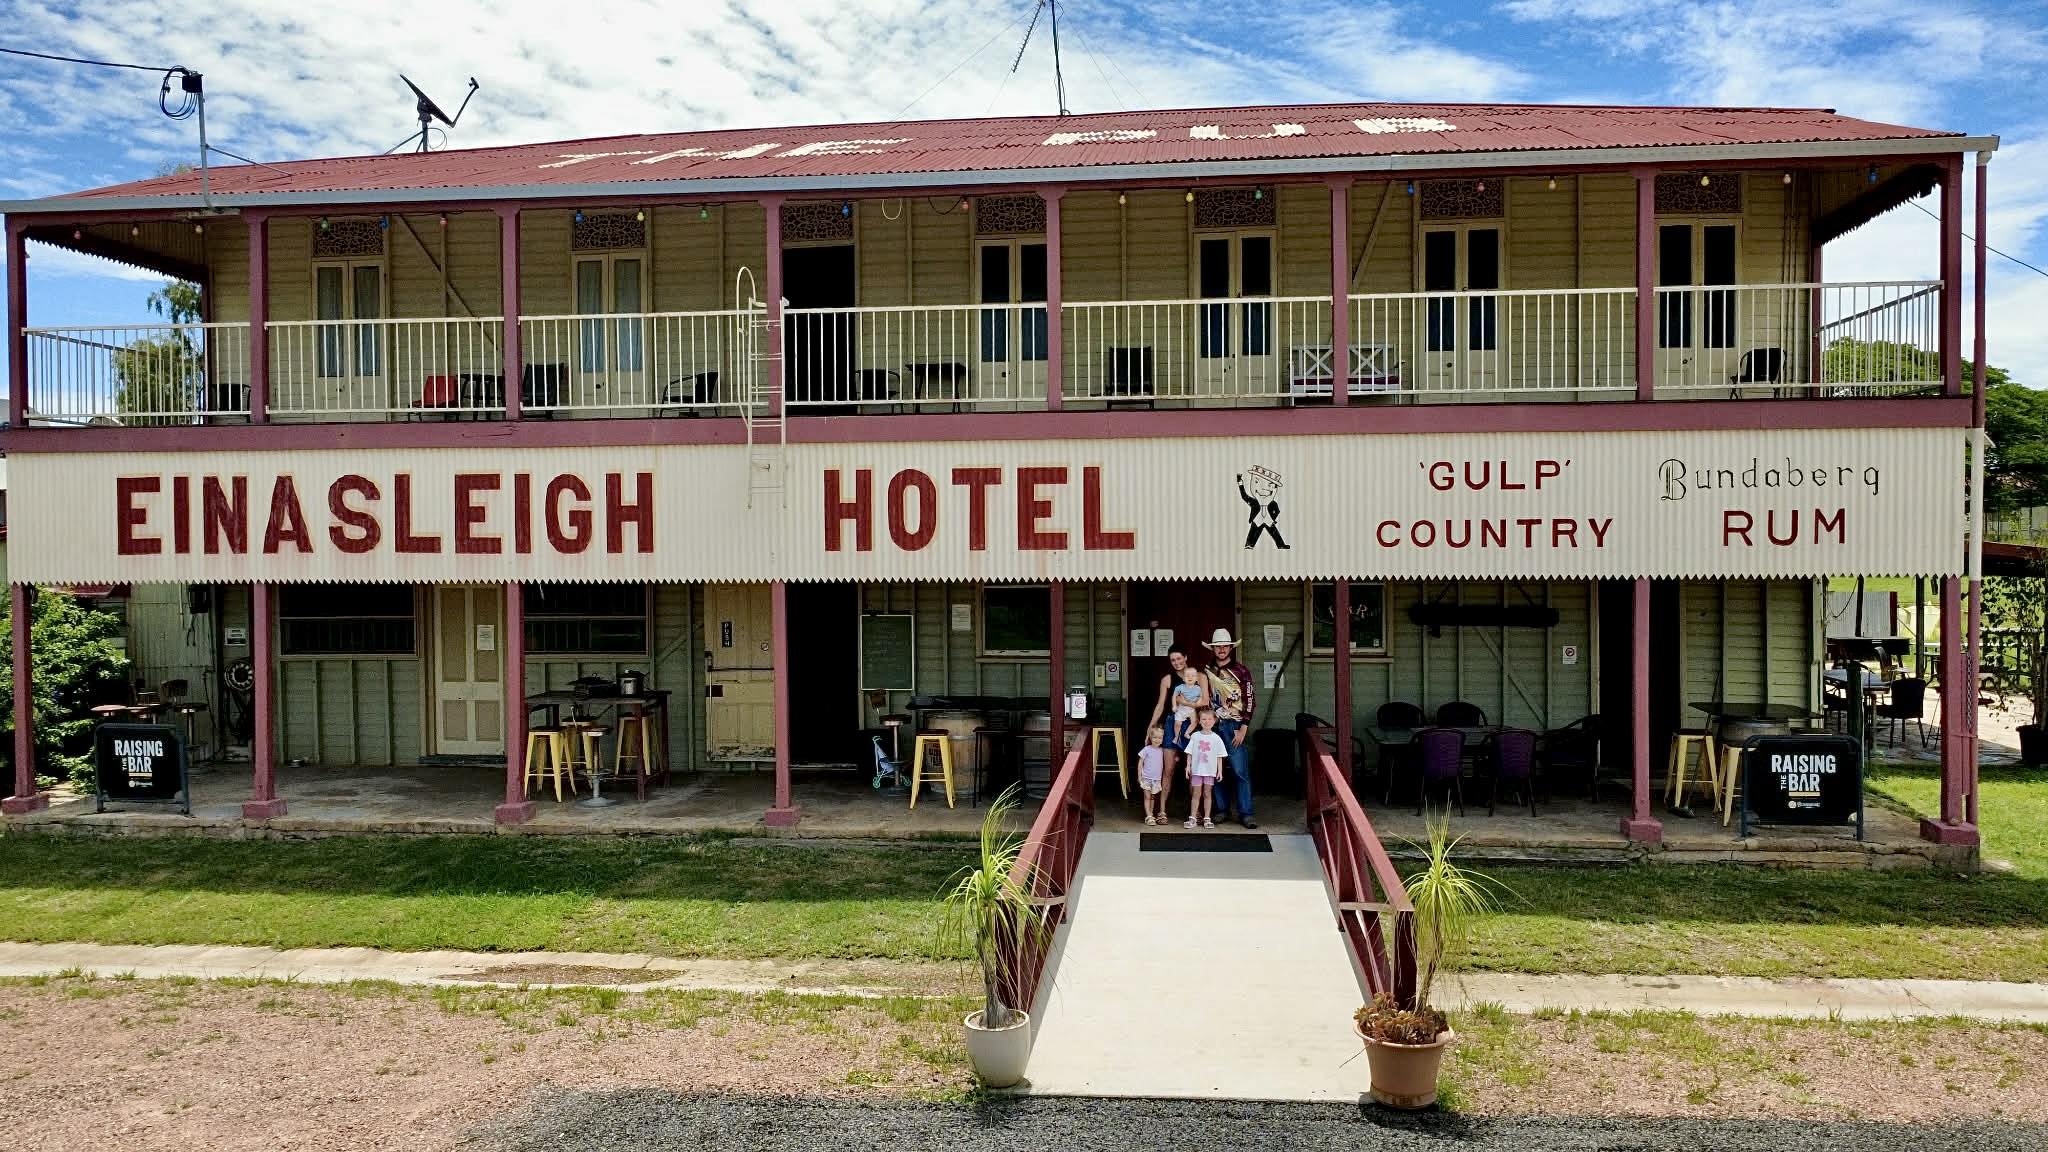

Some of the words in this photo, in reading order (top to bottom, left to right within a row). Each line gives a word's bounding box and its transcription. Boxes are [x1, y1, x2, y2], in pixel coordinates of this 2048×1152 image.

[538, 138, 914, 168] THE
[1041, 117, 1458, 145] PUB
[1659, 457, 1881, 501] Bundaberg
[117, 472, 654, 555] EINASLEIGH
[823, 466, 1136, 552] HOTEL
[1376, 518, 1614, 548] COUNTRY
[1723, 509, 1846, 546] RUM
[114, 740, 164, 757] RAISING
[1771, 754, 1836, 773] RAISING
[128, 757, 152, 772] BAR
[1788, 774, 1820, 791] BAR
